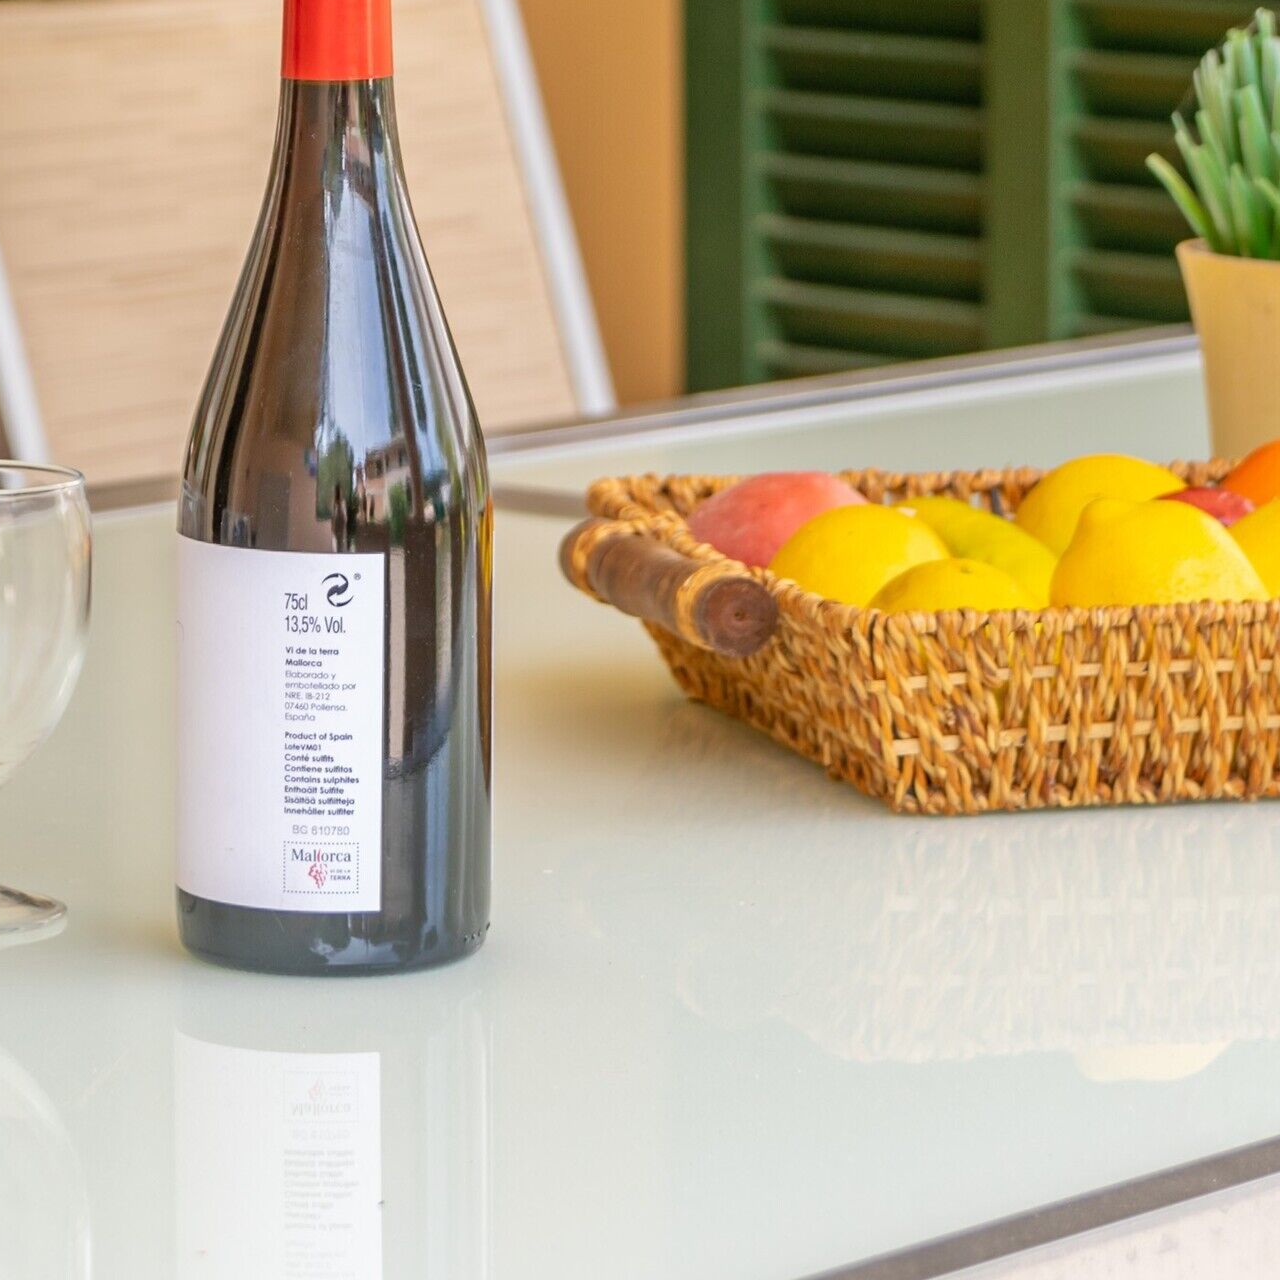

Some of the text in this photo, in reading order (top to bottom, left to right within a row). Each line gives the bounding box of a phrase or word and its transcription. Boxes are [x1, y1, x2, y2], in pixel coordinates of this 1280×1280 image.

[284, 593, 308, 610] 75cl
[285, 615, 346, 635] 13,5% Vol.
[295, 647, 307, 655] de
[309, 647, 317, 655] la
[285, 658, 322, 667] Mallorca
[285, 670, 329, 679] Elaborado
[285, 682, 356, 691] embotellado por
[285, 712, 316, 721] España
[285, 731, 317, 740] Product
[329, 733, 353, 741] Spain
[284, 753, 334, 762] Conté sulfits
[284, 764, 322, 773] Contiene
[284, 775, 359, 785] Contains sulphites
[284, 807, 325, 815] Innehåller
[292, 824, 308, 835] BG
[291, 848, 351, 862] Mallorca
